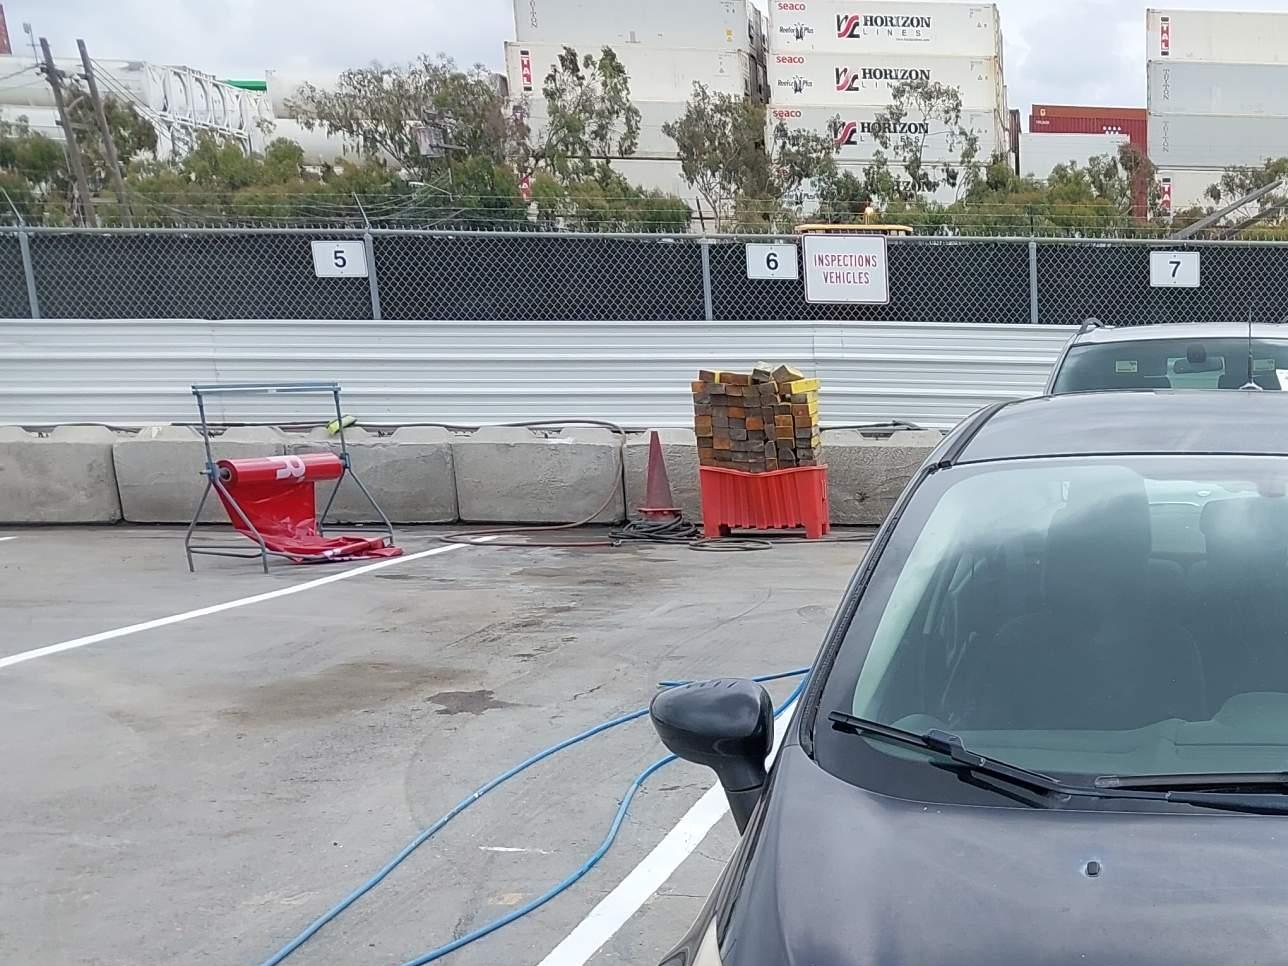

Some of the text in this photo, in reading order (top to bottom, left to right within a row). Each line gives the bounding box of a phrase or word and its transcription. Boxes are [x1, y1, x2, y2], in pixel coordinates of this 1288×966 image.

[777, 2, 807, 11] seaco
[862, 15, 931, 28] HORIZON
[862, 28, 921, 37] LINES
[775, 55, 805, 64] seaco
[861, 67, 931, 81] HORIZON
[772, 109, 802, 118] seaco
[860, 122, 929, 134] HORIZON
[333, 250, 347, 268] 5
[766, 252, 779, 270] 6
[813, 254, 877, 268] INSPECTIONS
[1169, 260, 1181, 278] 7
[822, 271, 870, 285] VEHICLES
